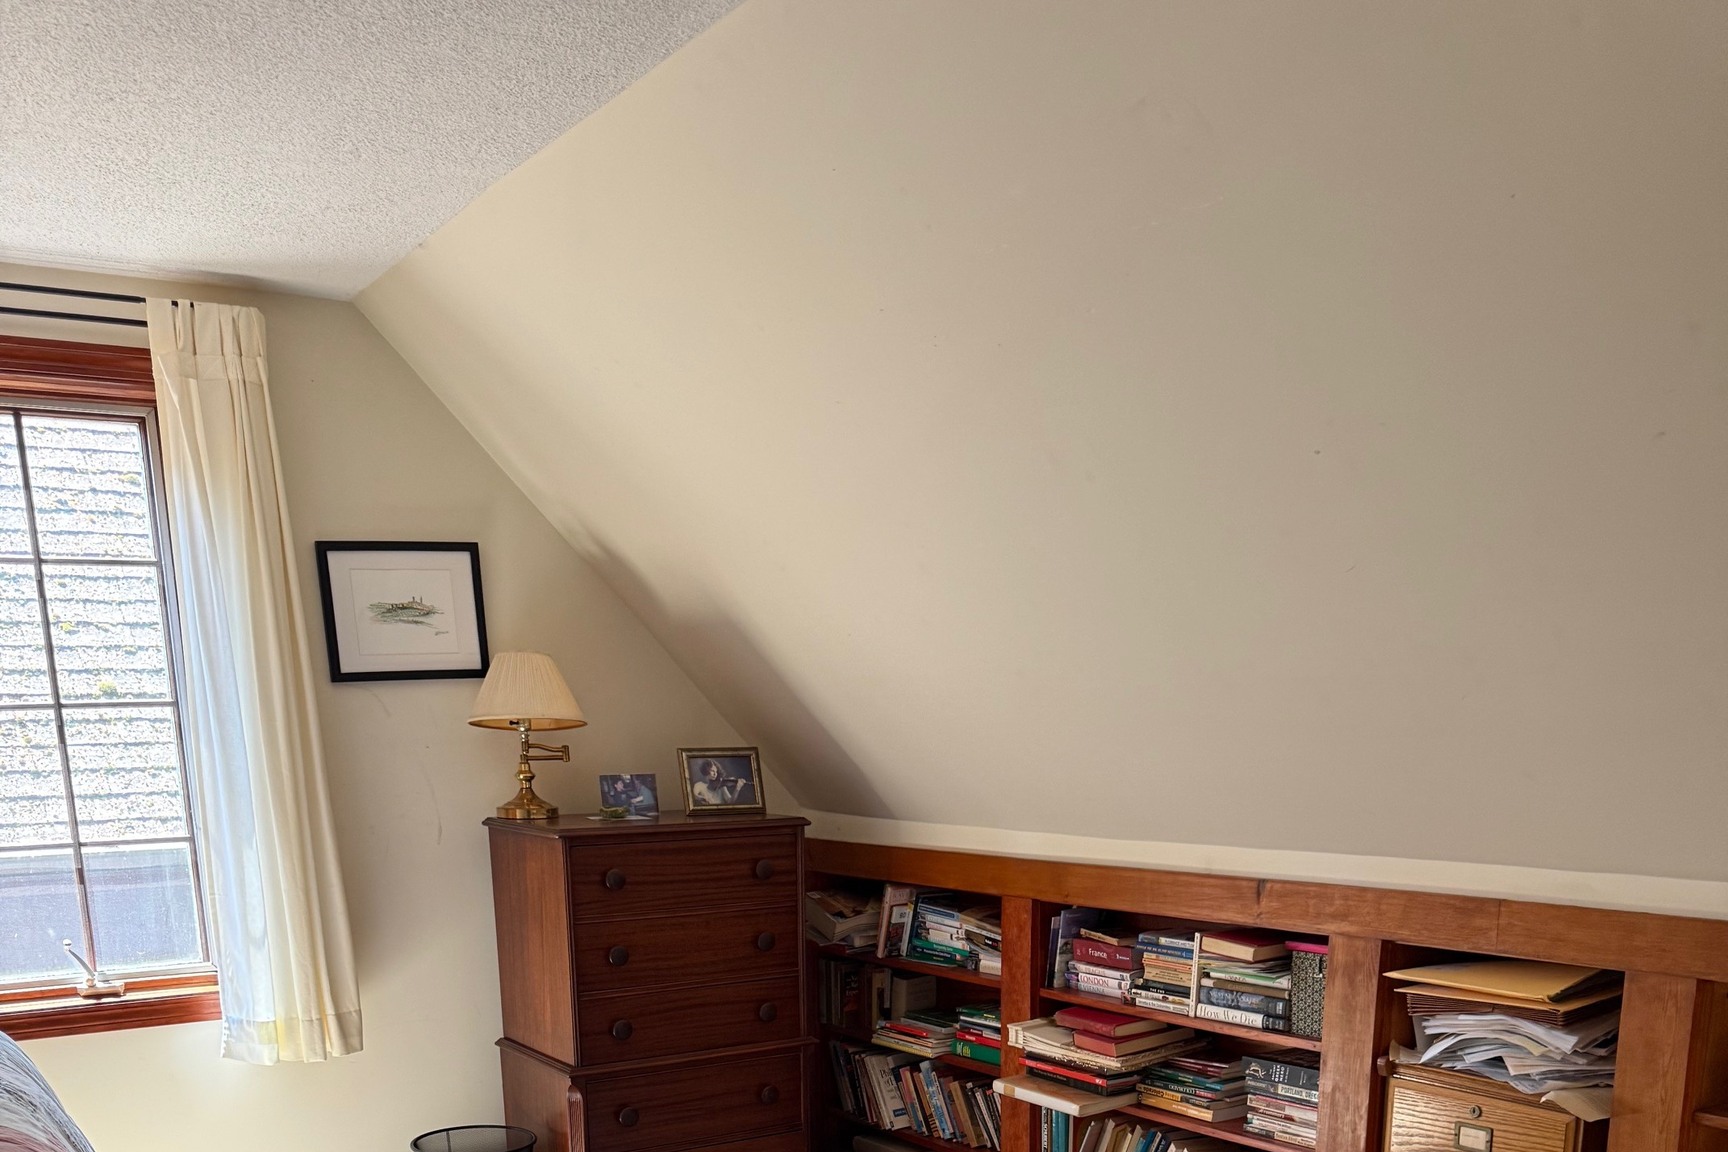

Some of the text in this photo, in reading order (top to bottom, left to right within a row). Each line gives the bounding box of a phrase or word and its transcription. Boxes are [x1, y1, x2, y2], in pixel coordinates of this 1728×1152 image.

[1088, 947, 1108, 959] France
[1080, 974, 1109, 988] LONDON
[1199, 1005, 1220, 1019] How
[1223, 1009, 1238, 1021] We
[1240, 1013, 1257, 1026] Die
[1168, 1084, 1195, 1095] COLORADO
